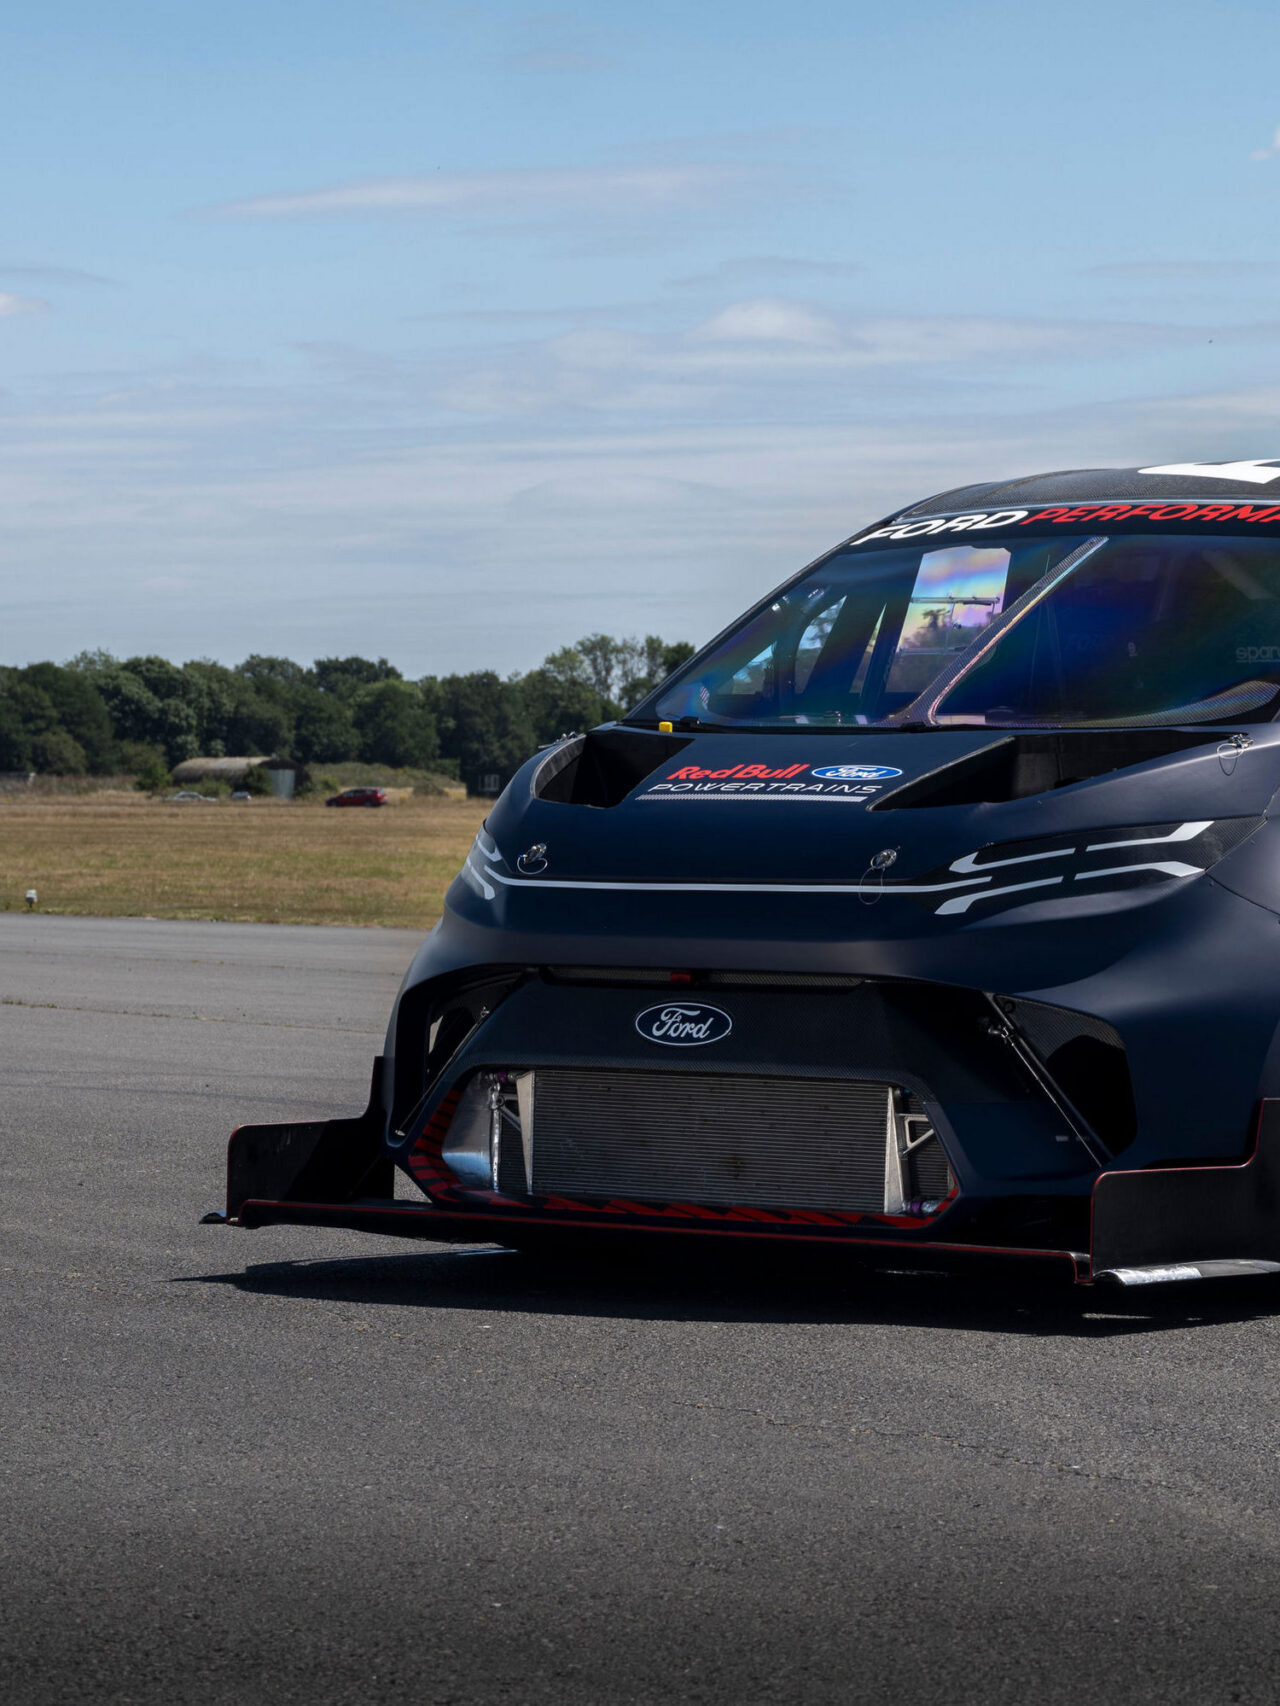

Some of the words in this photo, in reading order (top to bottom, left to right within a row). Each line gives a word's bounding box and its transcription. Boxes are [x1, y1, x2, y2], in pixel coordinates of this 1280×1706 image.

[849, 510, 1028, 546] FORD
[667, 764, 744, 780] Red
[733, 763, 811, 780] Bull
[825, 766, 887, 779] Ford
[648, 782, 883, 794] POWERTRAINS
[652, 1007, 714, 1039] Ford
